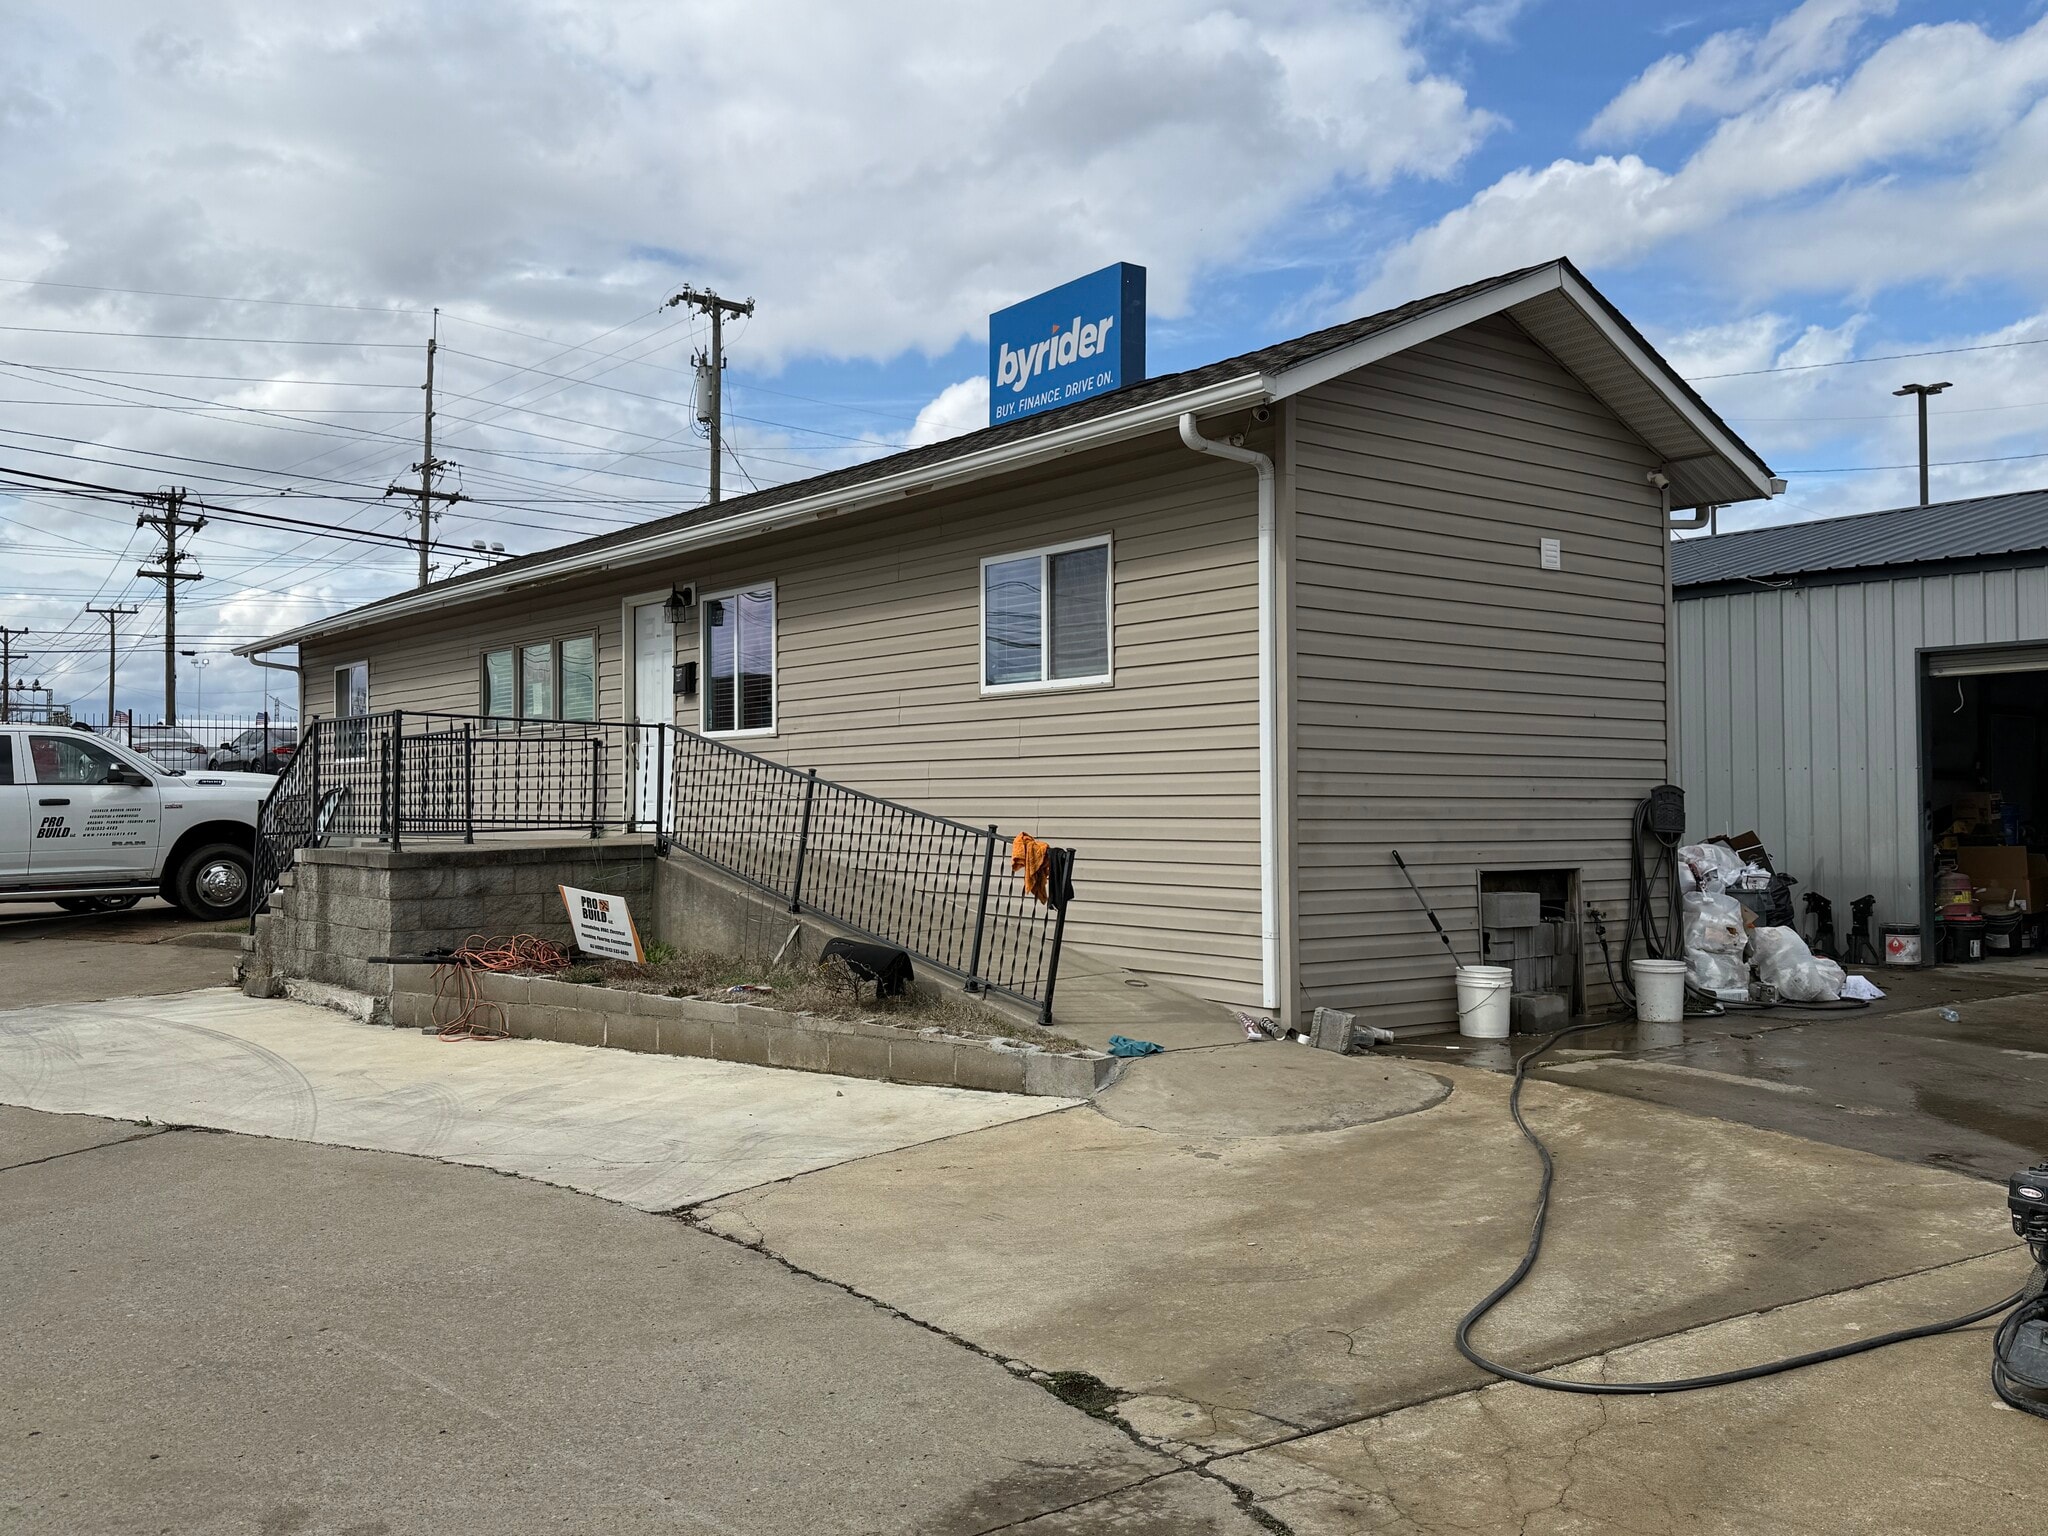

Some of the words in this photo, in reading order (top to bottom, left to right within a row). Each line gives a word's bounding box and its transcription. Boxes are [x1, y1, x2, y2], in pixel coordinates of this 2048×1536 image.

[996, 315, 1114, 392] byrider
[996, 403, 1016, 419] BUY.
[1018, 387, 1062, 412] FINANCE.
[1065, 376, 1095, 398] DRIVE
[1096, 370, 1114, 387] ON.
[41, 816, 64, 827] PRO
[37, 827, 71, 838] BUILD
[581, 896, 598, 909] PRO
[582, 908, 607, 922] BUILD
